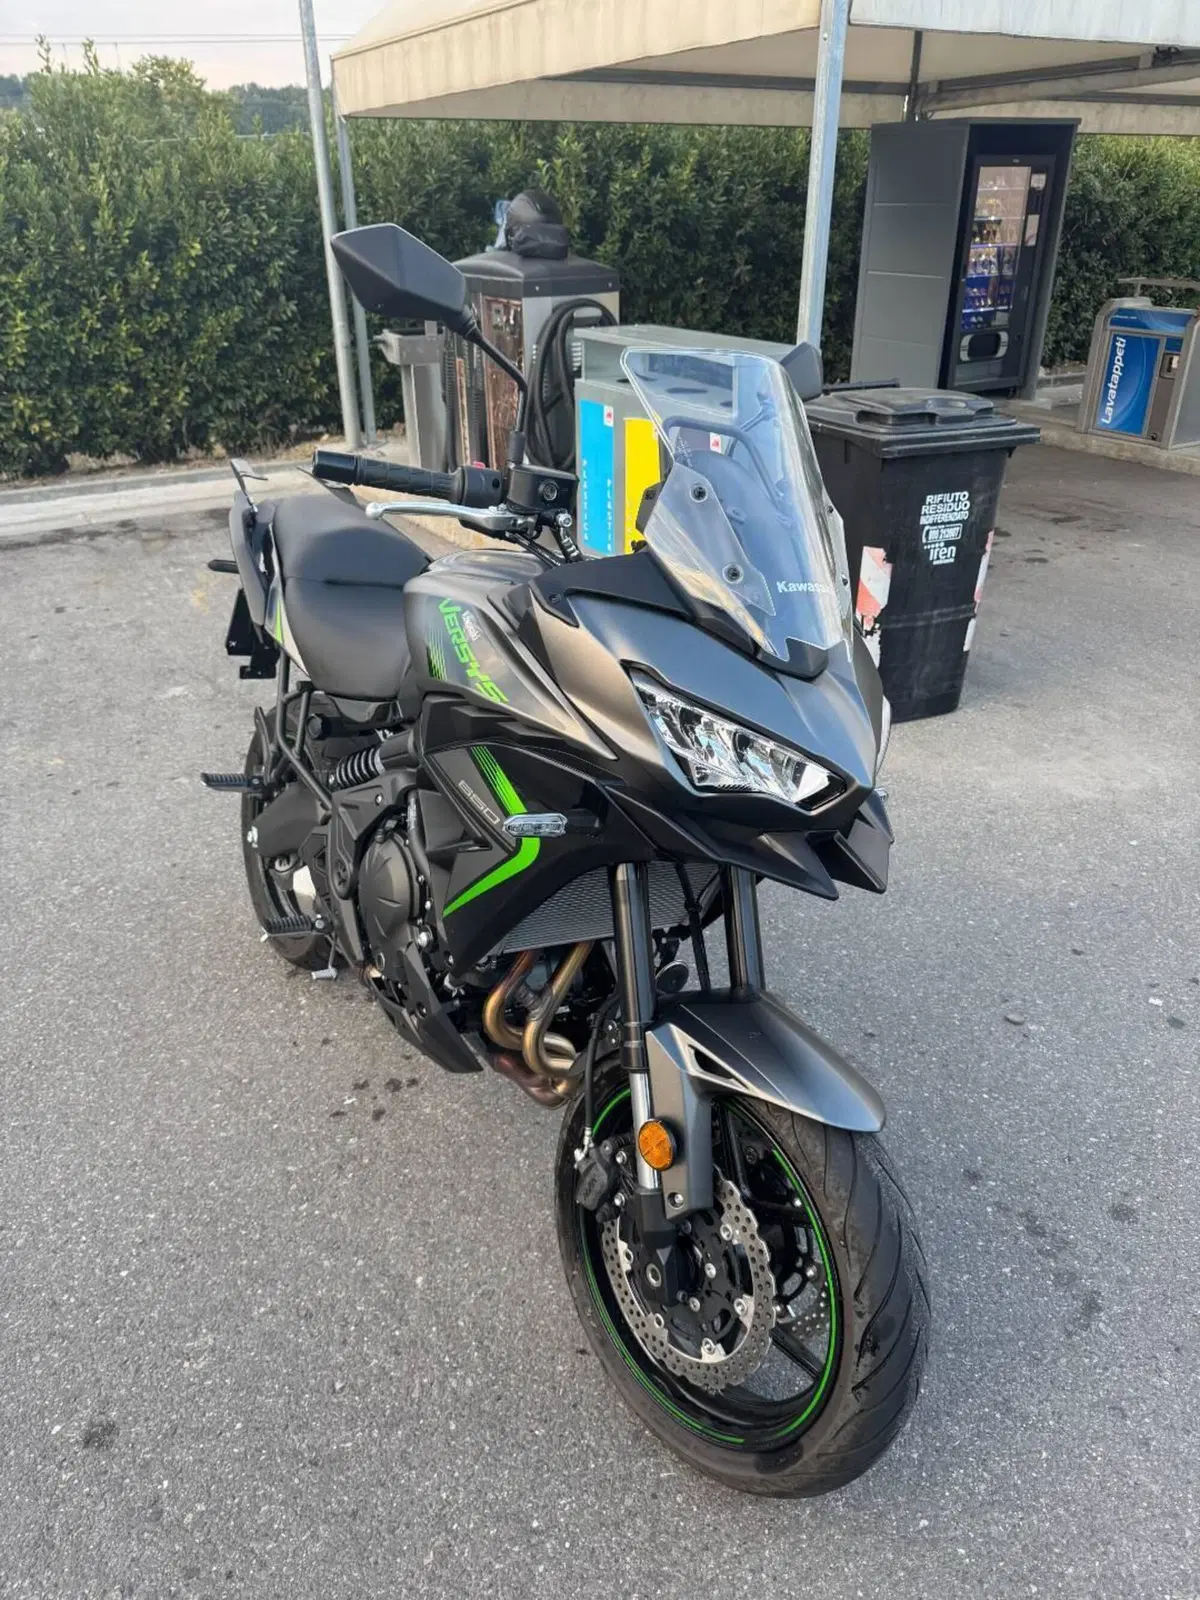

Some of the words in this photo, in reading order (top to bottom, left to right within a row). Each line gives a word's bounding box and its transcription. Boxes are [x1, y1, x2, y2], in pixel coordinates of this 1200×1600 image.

[1101, 336, 1126, 424] Lavatappeti
[921, 500, 971, 515] RESIDUO
[926, 491, 969, 505] RIFIUTO
[439, 598, 510, 704] VERSYS
[458, 780, 500, 824] 650
